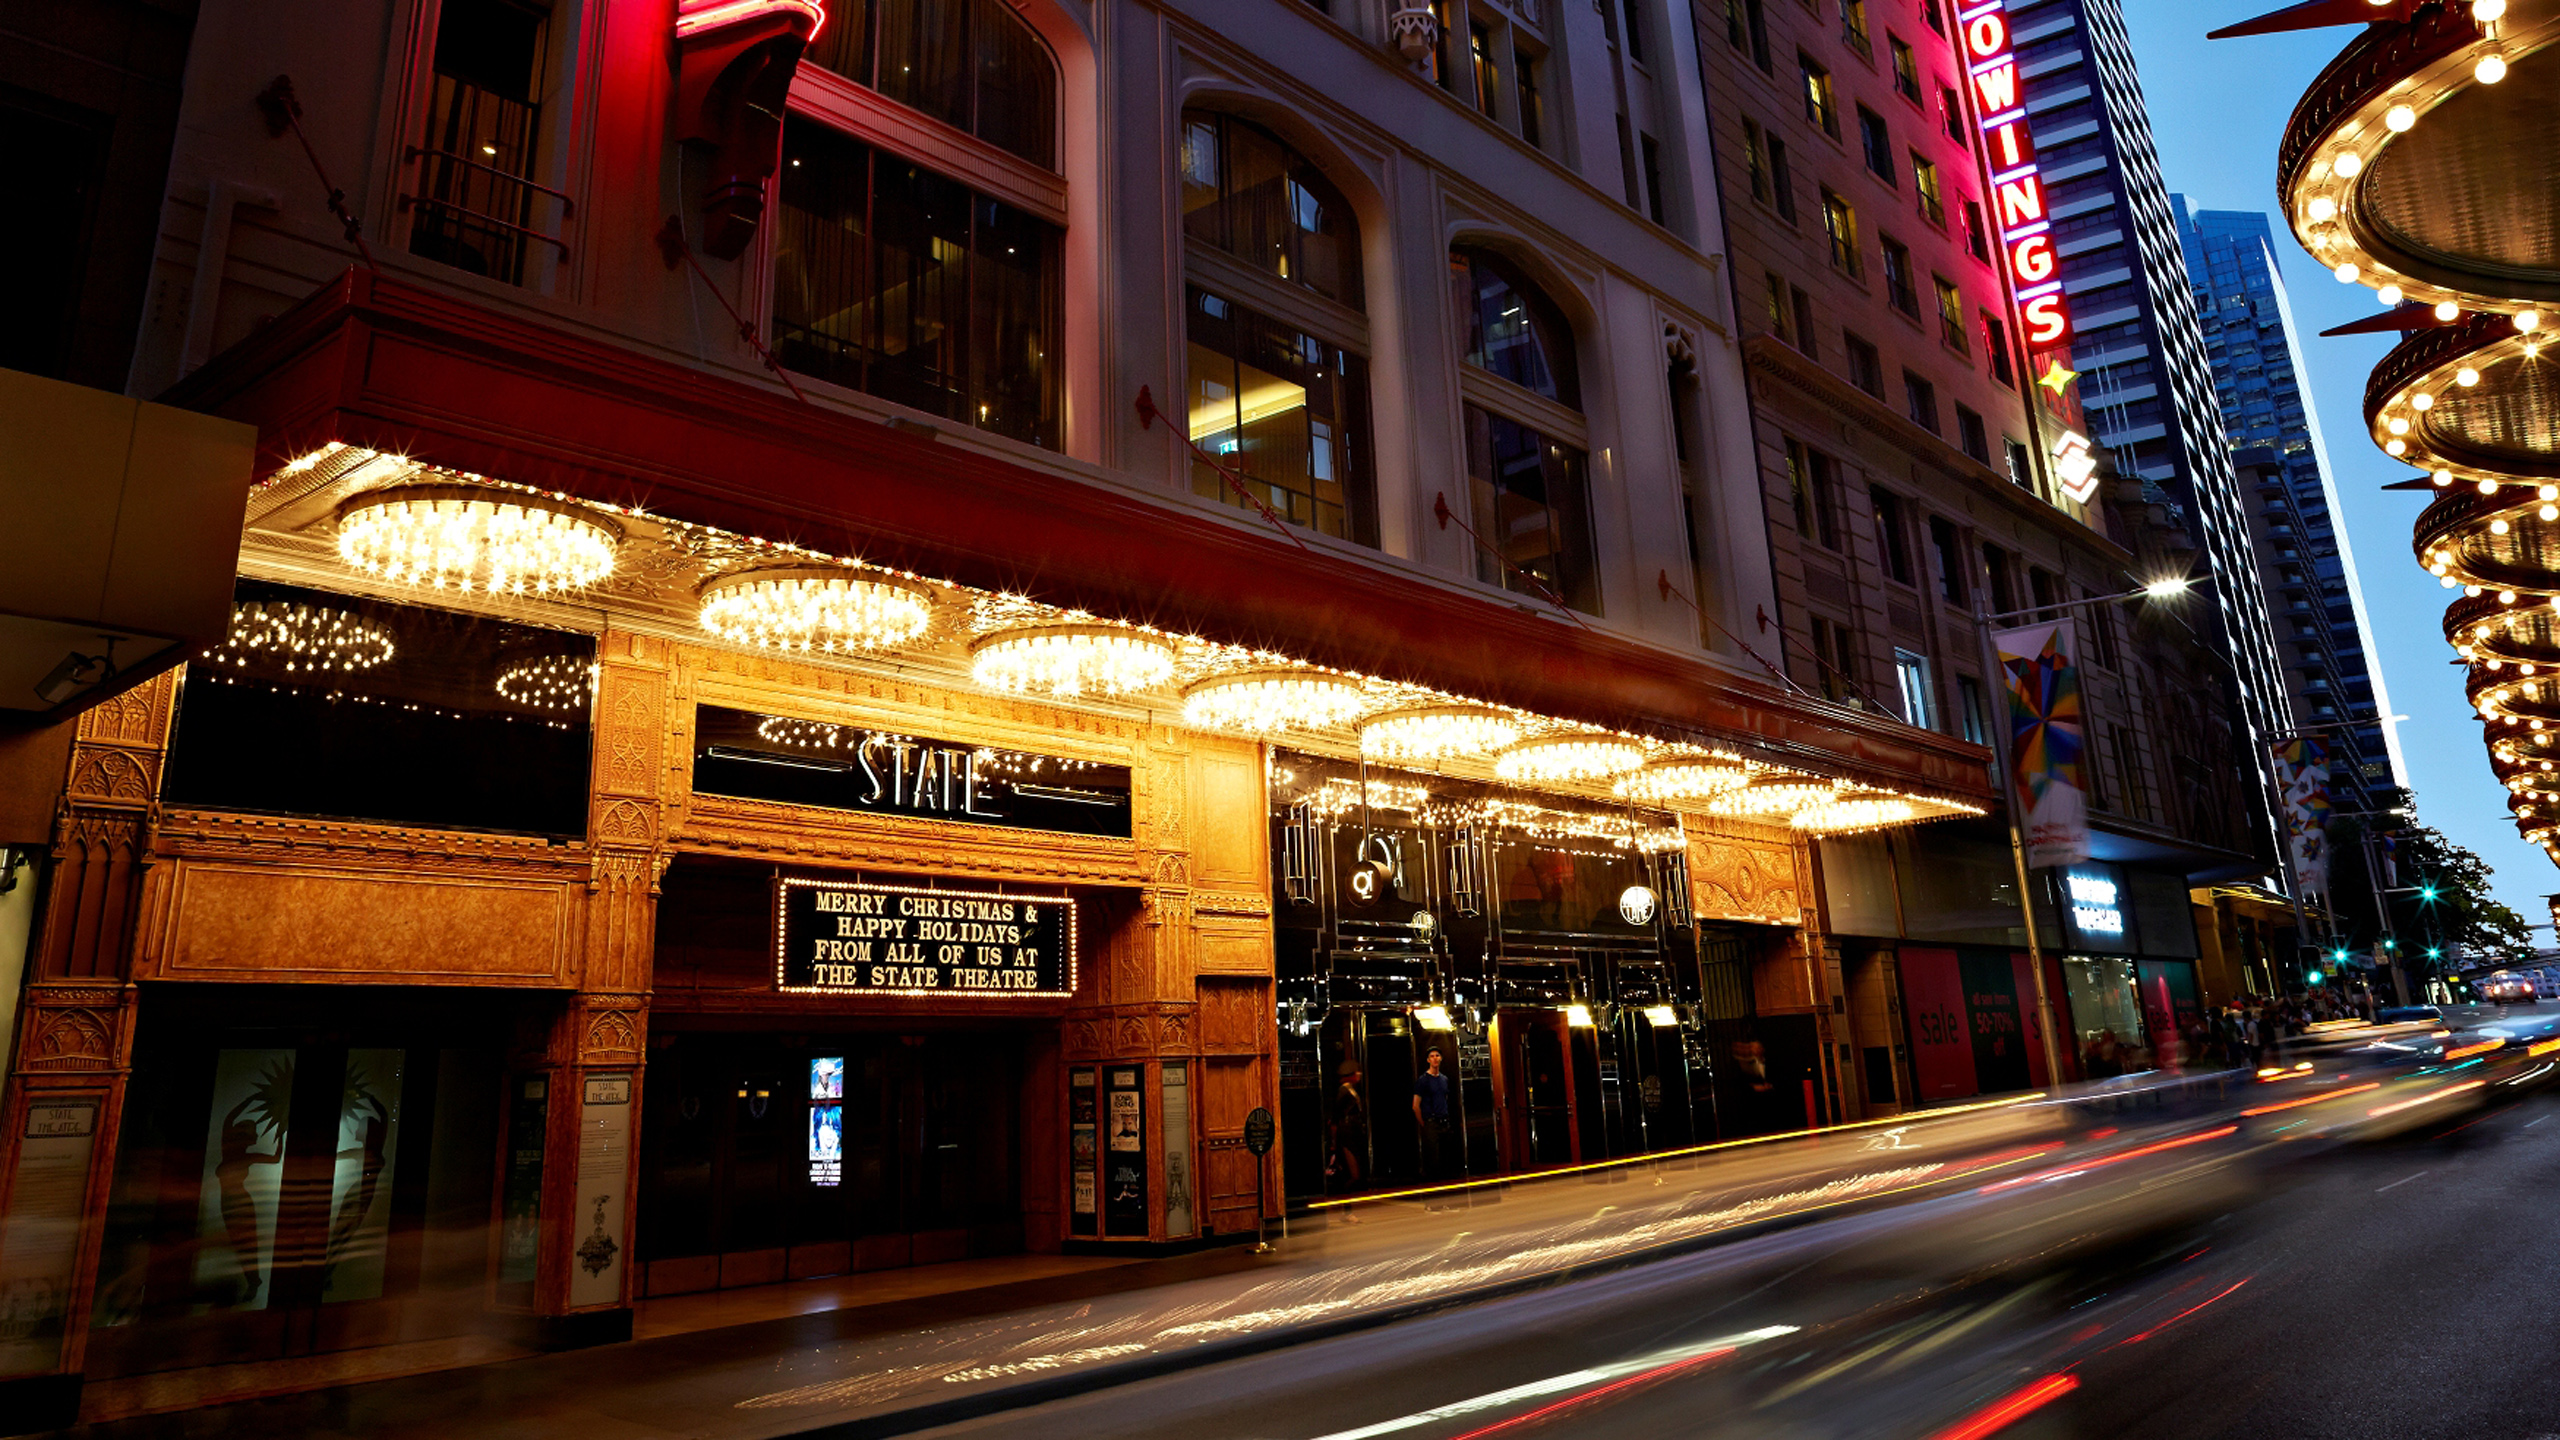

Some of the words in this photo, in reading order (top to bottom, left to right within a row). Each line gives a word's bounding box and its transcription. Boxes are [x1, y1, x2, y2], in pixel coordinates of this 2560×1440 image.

[1967, 0, 2065, 343] OWINGS
[858, 737, 1003, 817] STATE
[815, 890, 886, 914] MERRY
[899, 896, 1014, 921] CHRISTMAS
[1025, 904, 1038, 923] &
[837, 916, 906, 940] HAPPY
[918, 920, 1020, 944] HOLIDAYS
[814, 939, 872, 962] FROM
[885, 942, 926, 964] ALL
[938, 945, 965, 965] OF
[977, 946, 1003, 966] US
[1013, 948, 1038, 967] AT
[813, 964, 857, 985] THE
[871, 966, 938, 987] STATE
[951, 968, 1038, 989] THEATRE
[1920, 1003, 1959, 1045] sale
